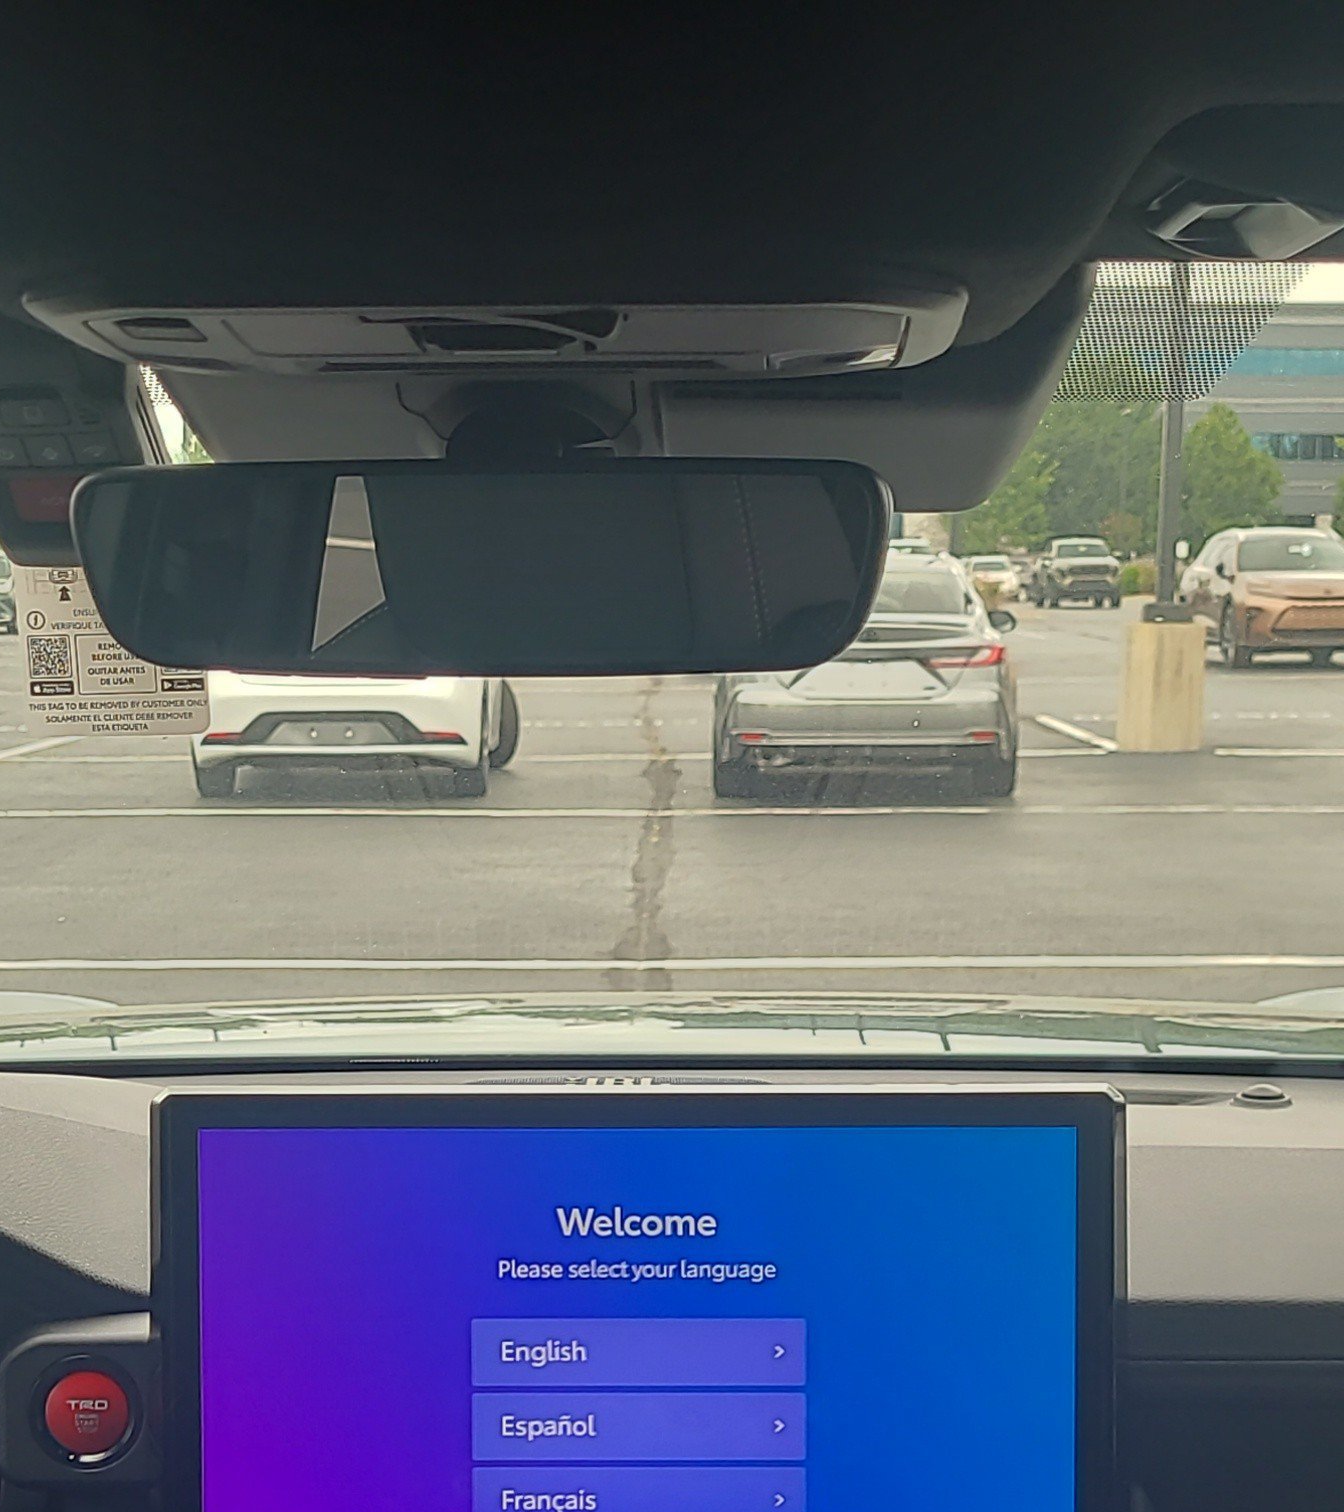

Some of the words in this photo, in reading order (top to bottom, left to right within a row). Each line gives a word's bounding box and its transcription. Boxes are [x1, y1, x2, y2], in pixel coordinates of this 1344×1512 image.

[91, 653, 123, 661] BEFORE
[87, 667, 118, 675] QUITAR
[119, 666, 146, 674] ANTES
[112, 677, 135, 685] USAR
[29, 703, 47, 711] THIS
[48, 703, 65, 711] TAG
[65, 702, 77, 710] TO
[78, 702, 89, 710] BE
[89, 701, 129, 710] REMOVED
[130, 701, 141, 709] BY
[141, 700, 186, 708] CUSTOMER
[186, 699, 208, 708] ONLY
[45, 715, 92, 723] SOLAMENTE
[103, 714, 134, 722] CLIENTE
[135, 713, 155, 721] DEBE
[156, 712, 194, 720] REMOVER
[91, 724, 110, 732] ESTA
[111, 723, 149, 732] ETIQUETA
[556, 1206, 718, 1237] Welcome
[498, 1259, 564, 1279] Please
[567, 1259, 629, 1279] select
[631, 1262, 677, 1282] your
[680, 1259, 777, 1283] language
[501, 1340, 587, 1368] English
[65, 1399, 109, 1411] TRD
[501, 1415, 597, 1442] Español
